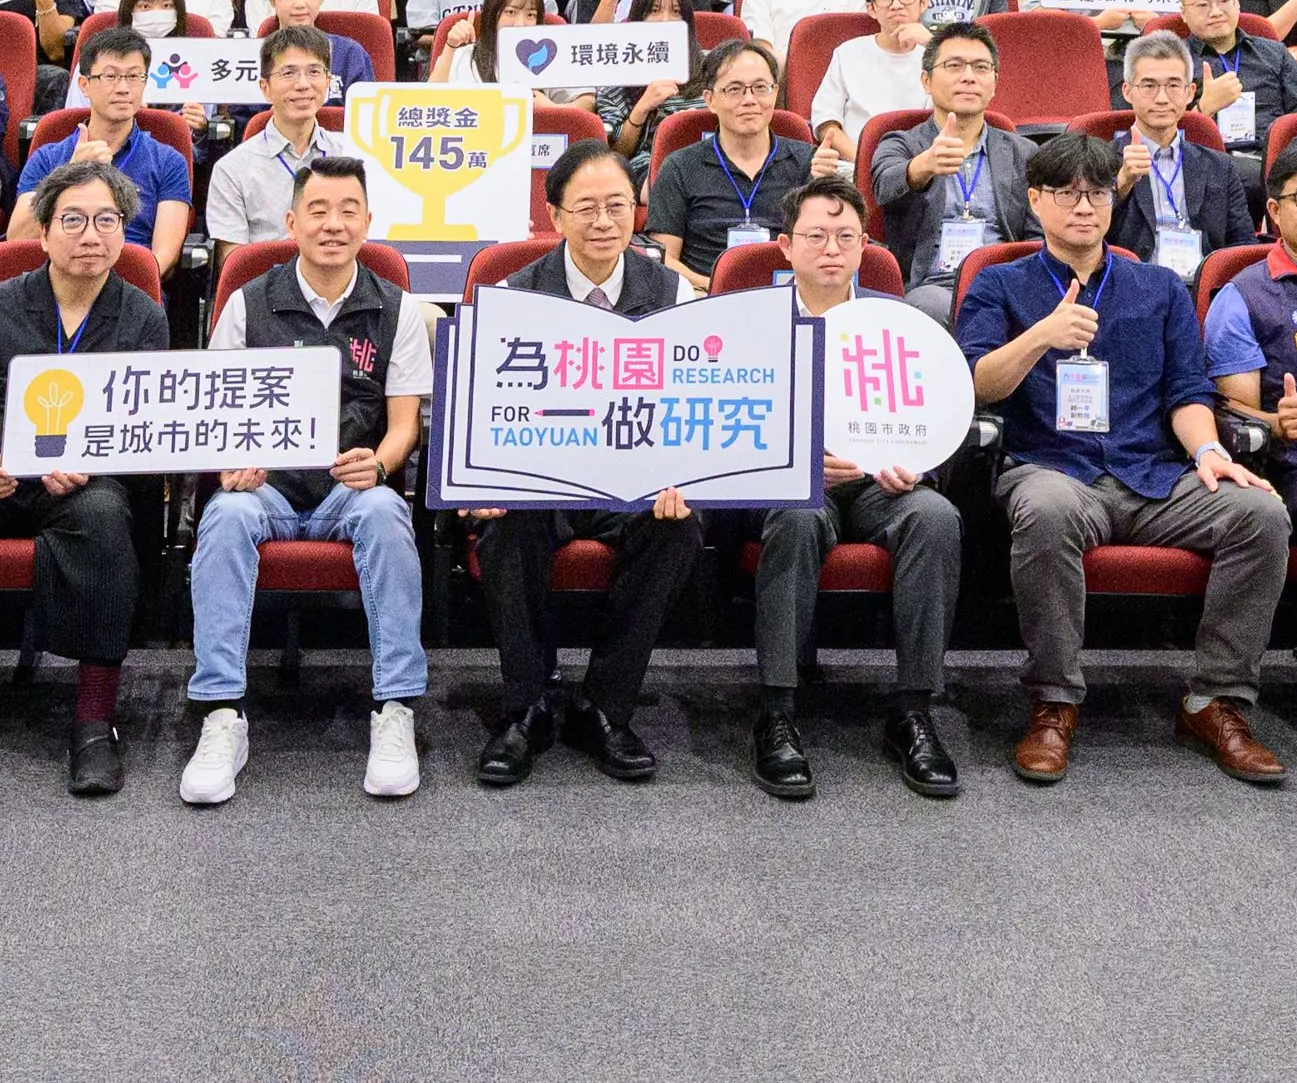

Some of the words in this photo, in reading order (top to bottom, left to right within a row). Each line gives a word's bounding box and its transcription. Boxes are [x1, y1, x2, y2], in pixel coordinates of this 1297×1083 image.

[570, 40, 670, 66] 環境永續
[211, 59, 259, 83] 多元
[398, 107, 479, 128] 總獎金
[390, 136, 487, 170] 145萬
[496, 336, 664, 391] 為桃園
[673, 344, 700, 362] DO
[672, 368, 775, 385] RESEARCH
[101, 365, 295, 414] 你的提案
[491, 407, 530, 423] FOR
[601, 394, 773, 451] 做研究
[490, 427, 598, 447] TAOYUAN
[848, 420, 927, 437] 桃園市政府
